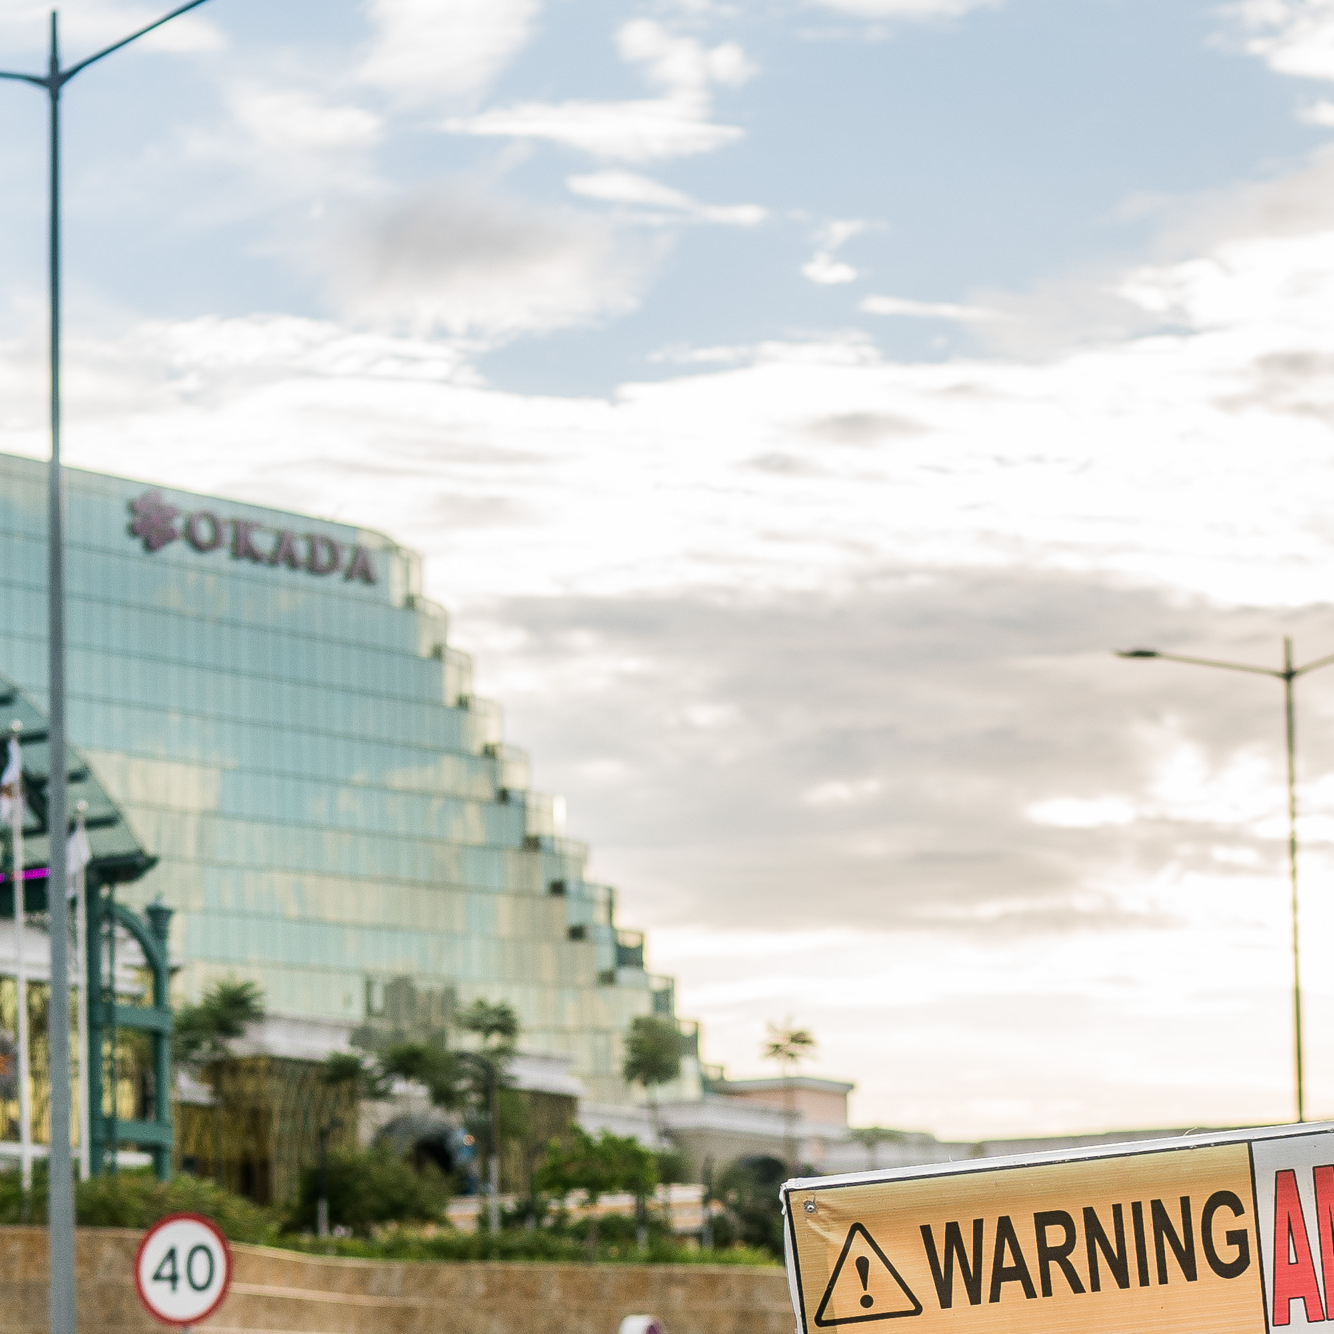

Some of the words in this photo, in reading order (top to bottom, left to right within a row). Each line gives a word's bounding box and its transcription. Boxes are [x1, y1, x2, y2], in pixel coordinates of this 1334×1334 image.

[185, 509, 377, 585] OKADA
[153, 1245, 215, 1293] 40
[919, 1190, 1251, 1309] WARNING
